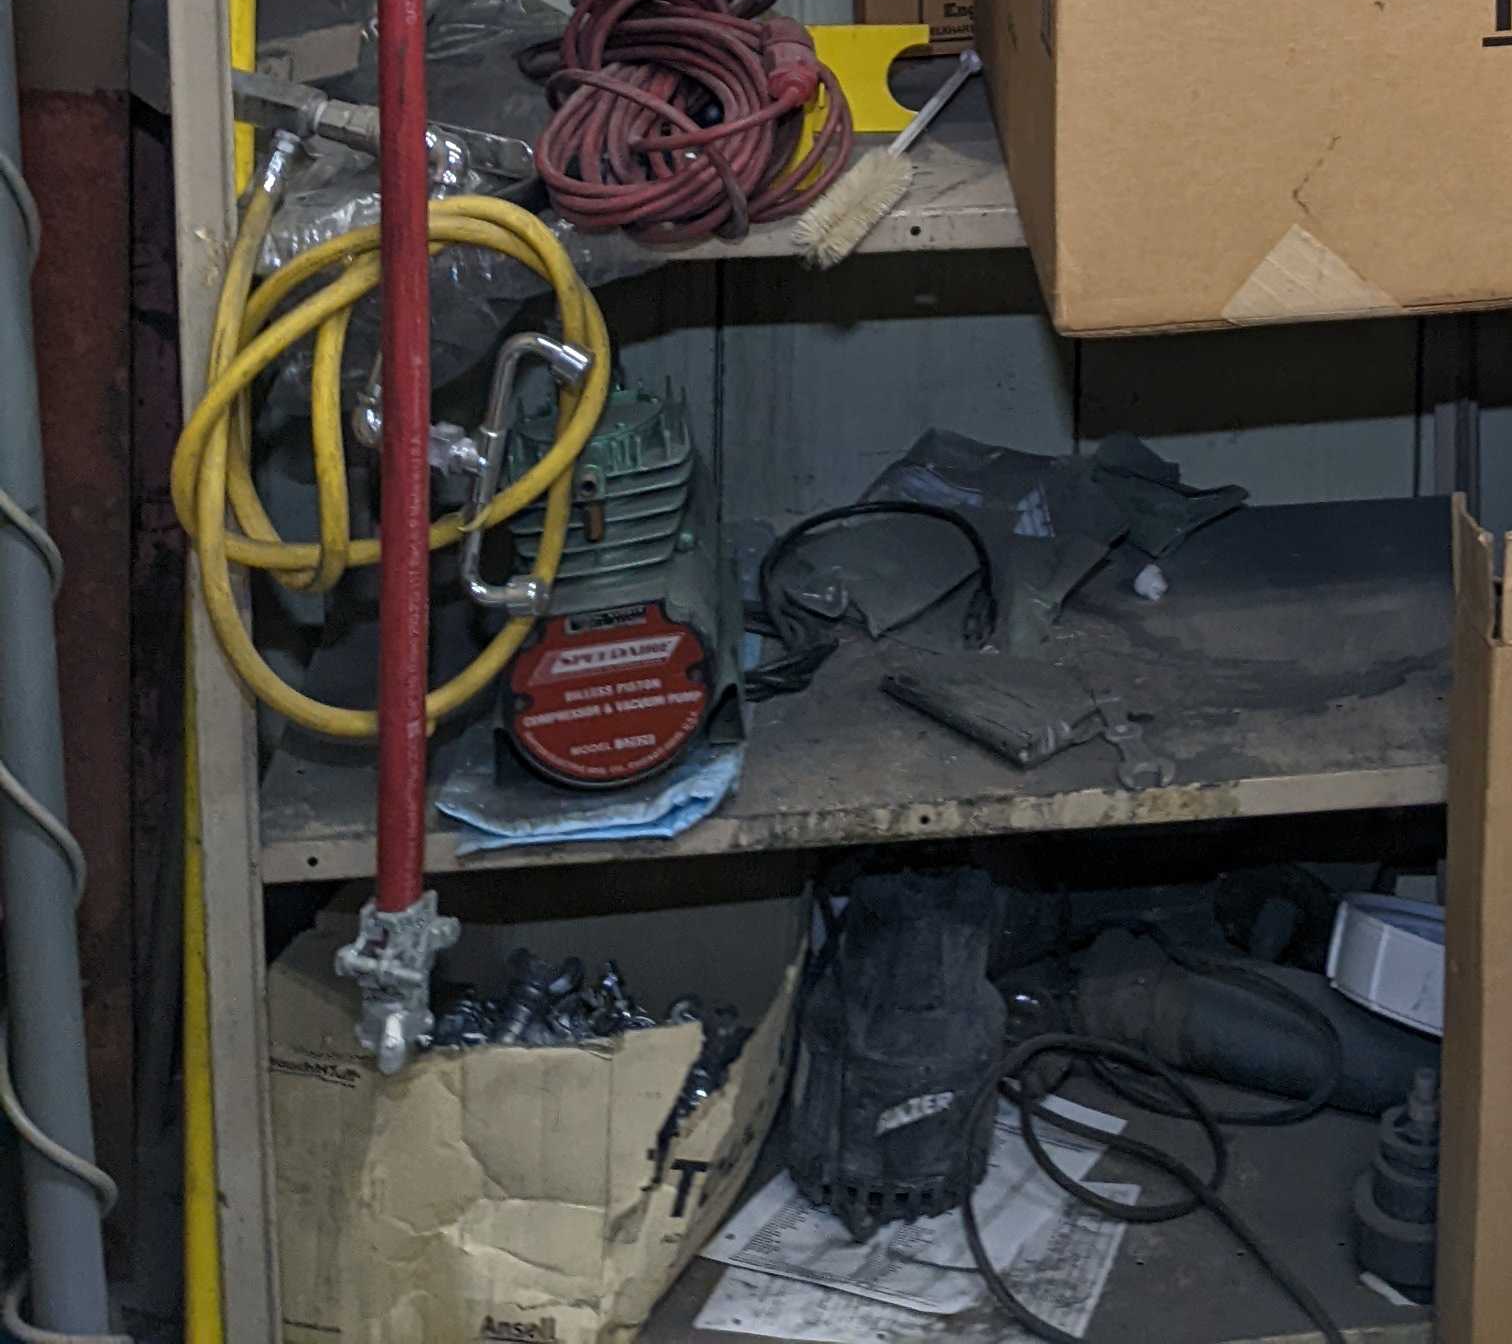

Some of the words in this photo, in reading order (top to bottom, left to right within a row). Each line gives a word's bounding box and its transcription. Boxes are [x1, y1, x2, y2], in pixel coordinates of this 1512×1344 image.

[615, 695, 666, 712] VACUUM
[570, 743, 613, 756] MODEL
[480, 1315, 558, 1342] Ansell
